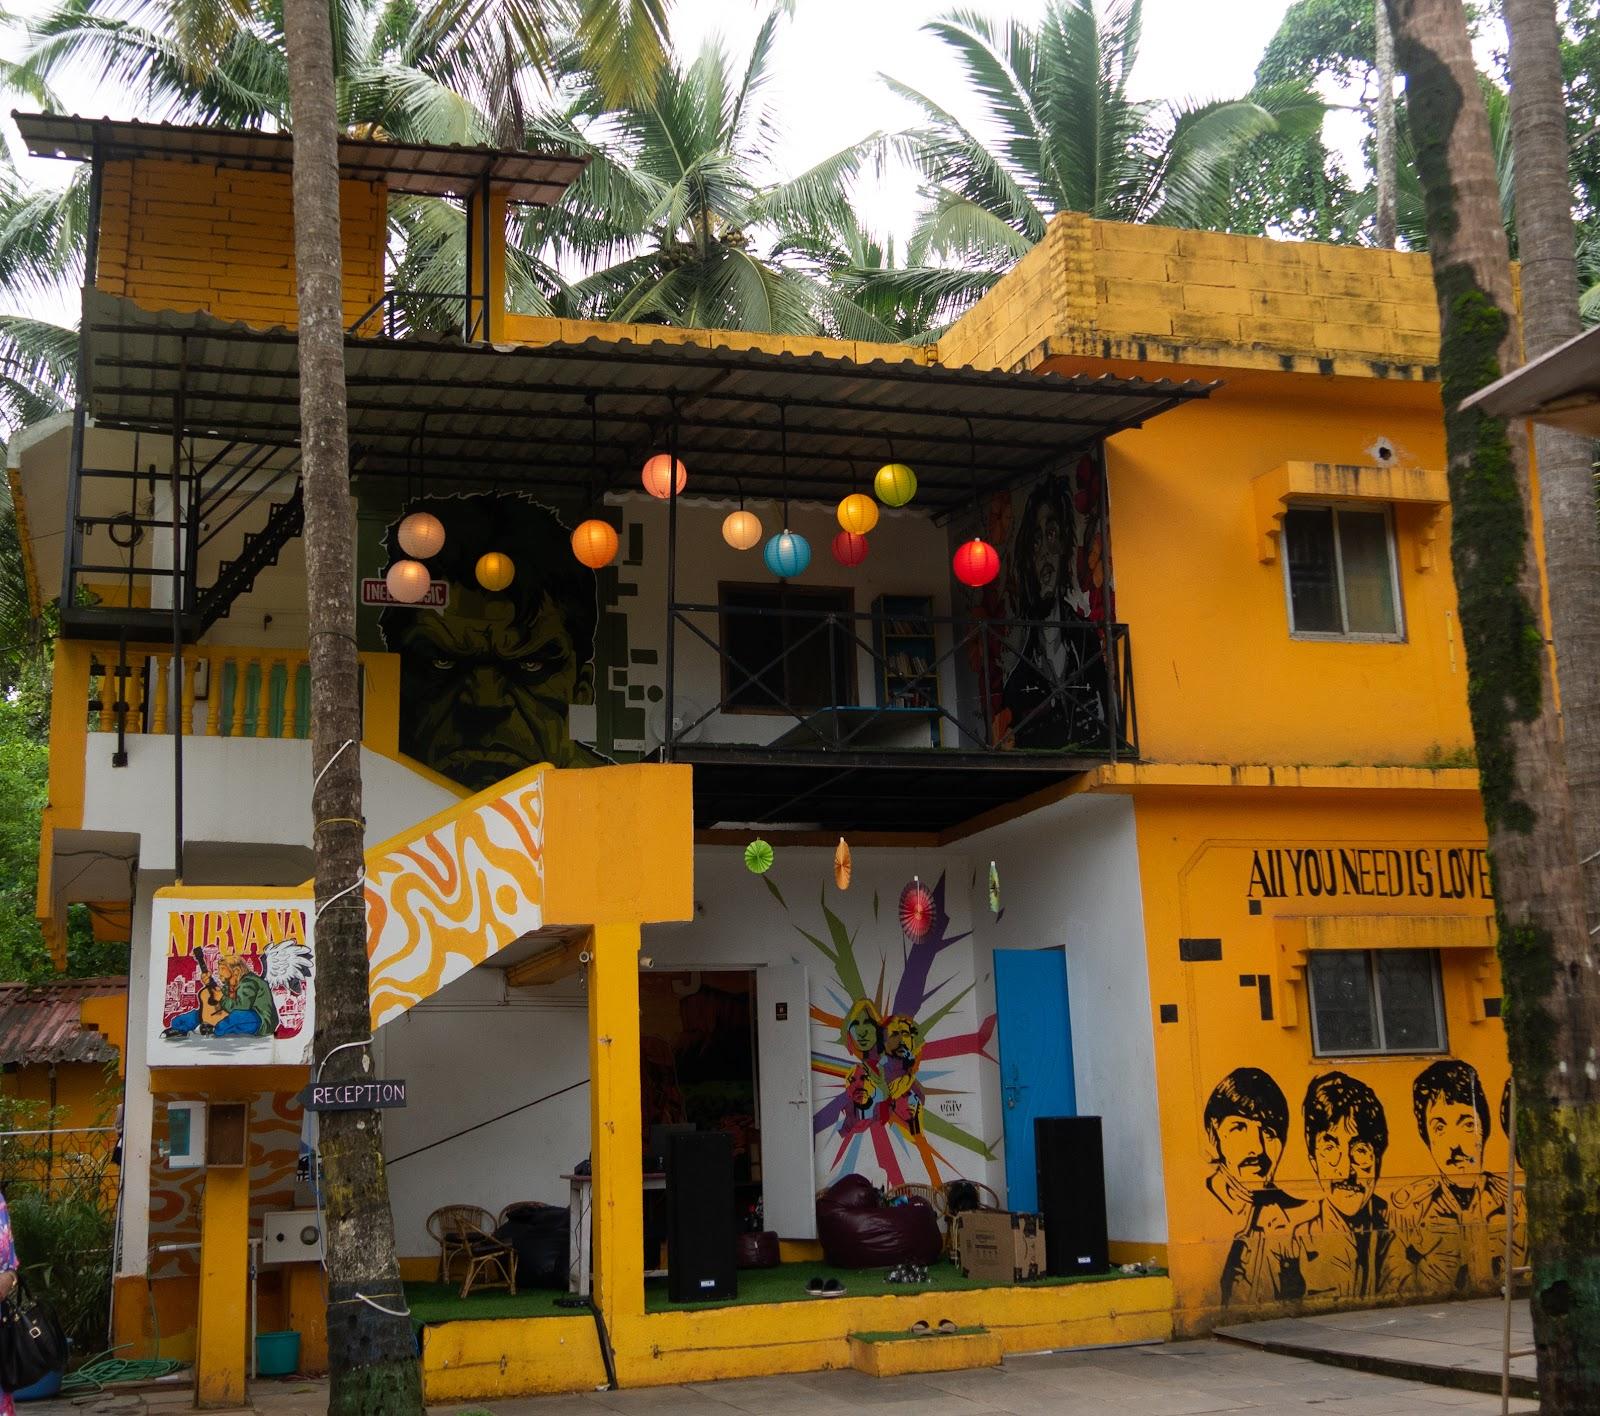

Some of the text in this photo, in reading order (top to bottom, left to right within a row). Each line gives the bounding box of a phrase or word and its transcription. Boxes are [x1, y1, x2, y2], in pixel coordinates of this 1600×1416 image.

[1284, 848, 1338, 897] YOU
[1339, 848, 1404, 897] NEED
[1403, 848, 1434, 898] IS
[1435, 848, 1495, 899] LOVE
[166, 908, 307, 957] NIRVANA
[313, 1084, 406, 1105] RECEPTION
